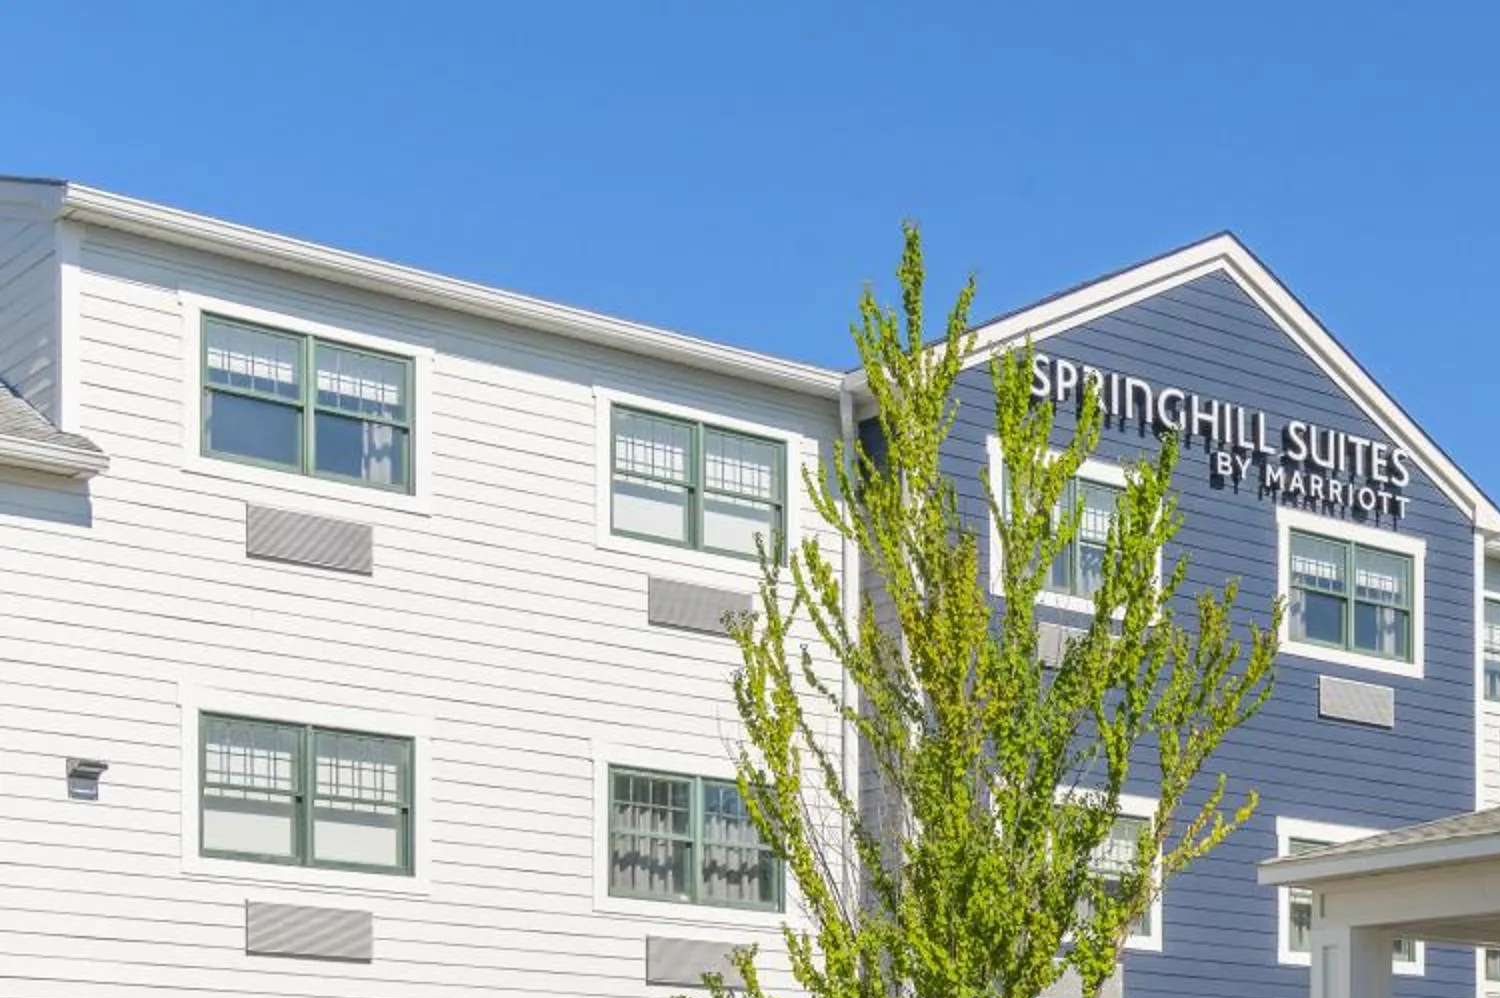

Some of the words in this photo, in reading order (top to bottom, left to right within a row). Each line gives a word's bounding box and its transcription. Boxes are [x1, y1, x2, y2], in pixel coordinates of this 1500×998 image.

[1031, 353, 1275, 455] SPRINGHILL
[1287, 420, 1410, 487] SUITES
[1217, 451, 1251, 480] BY
[1265, 463, 1411, 520] MARRIOTT
